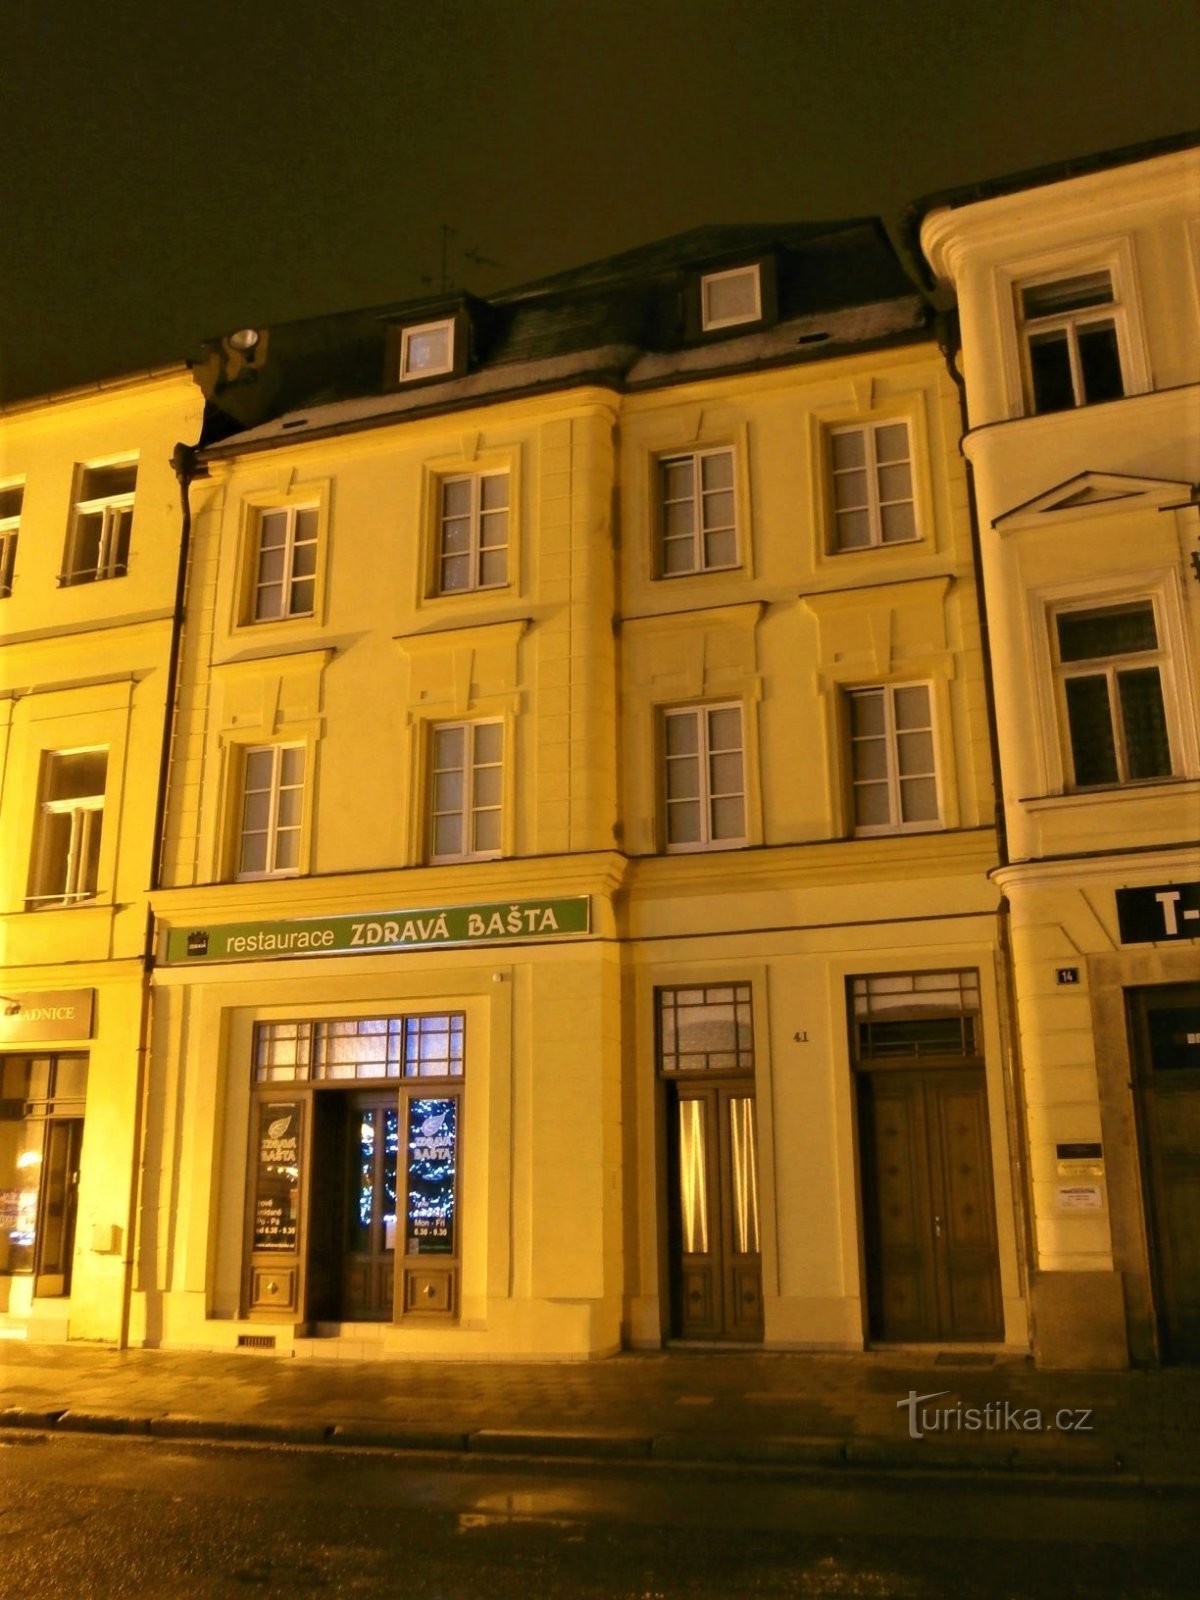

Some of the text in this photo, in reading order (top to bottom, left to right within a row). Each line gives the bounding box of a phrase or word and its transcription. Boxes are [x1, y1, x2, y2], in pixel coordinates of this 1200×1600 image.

[227, 905, 559, 953] restaurace ZDRAVÁ BAŠTA
[1062, 970, 1073, 982] 14
[793, 1031, 809, 1043] 41
[261, 1148, 296, 1162] BAŠTA
[414, 1147, 451, 1160] BAŠTA
